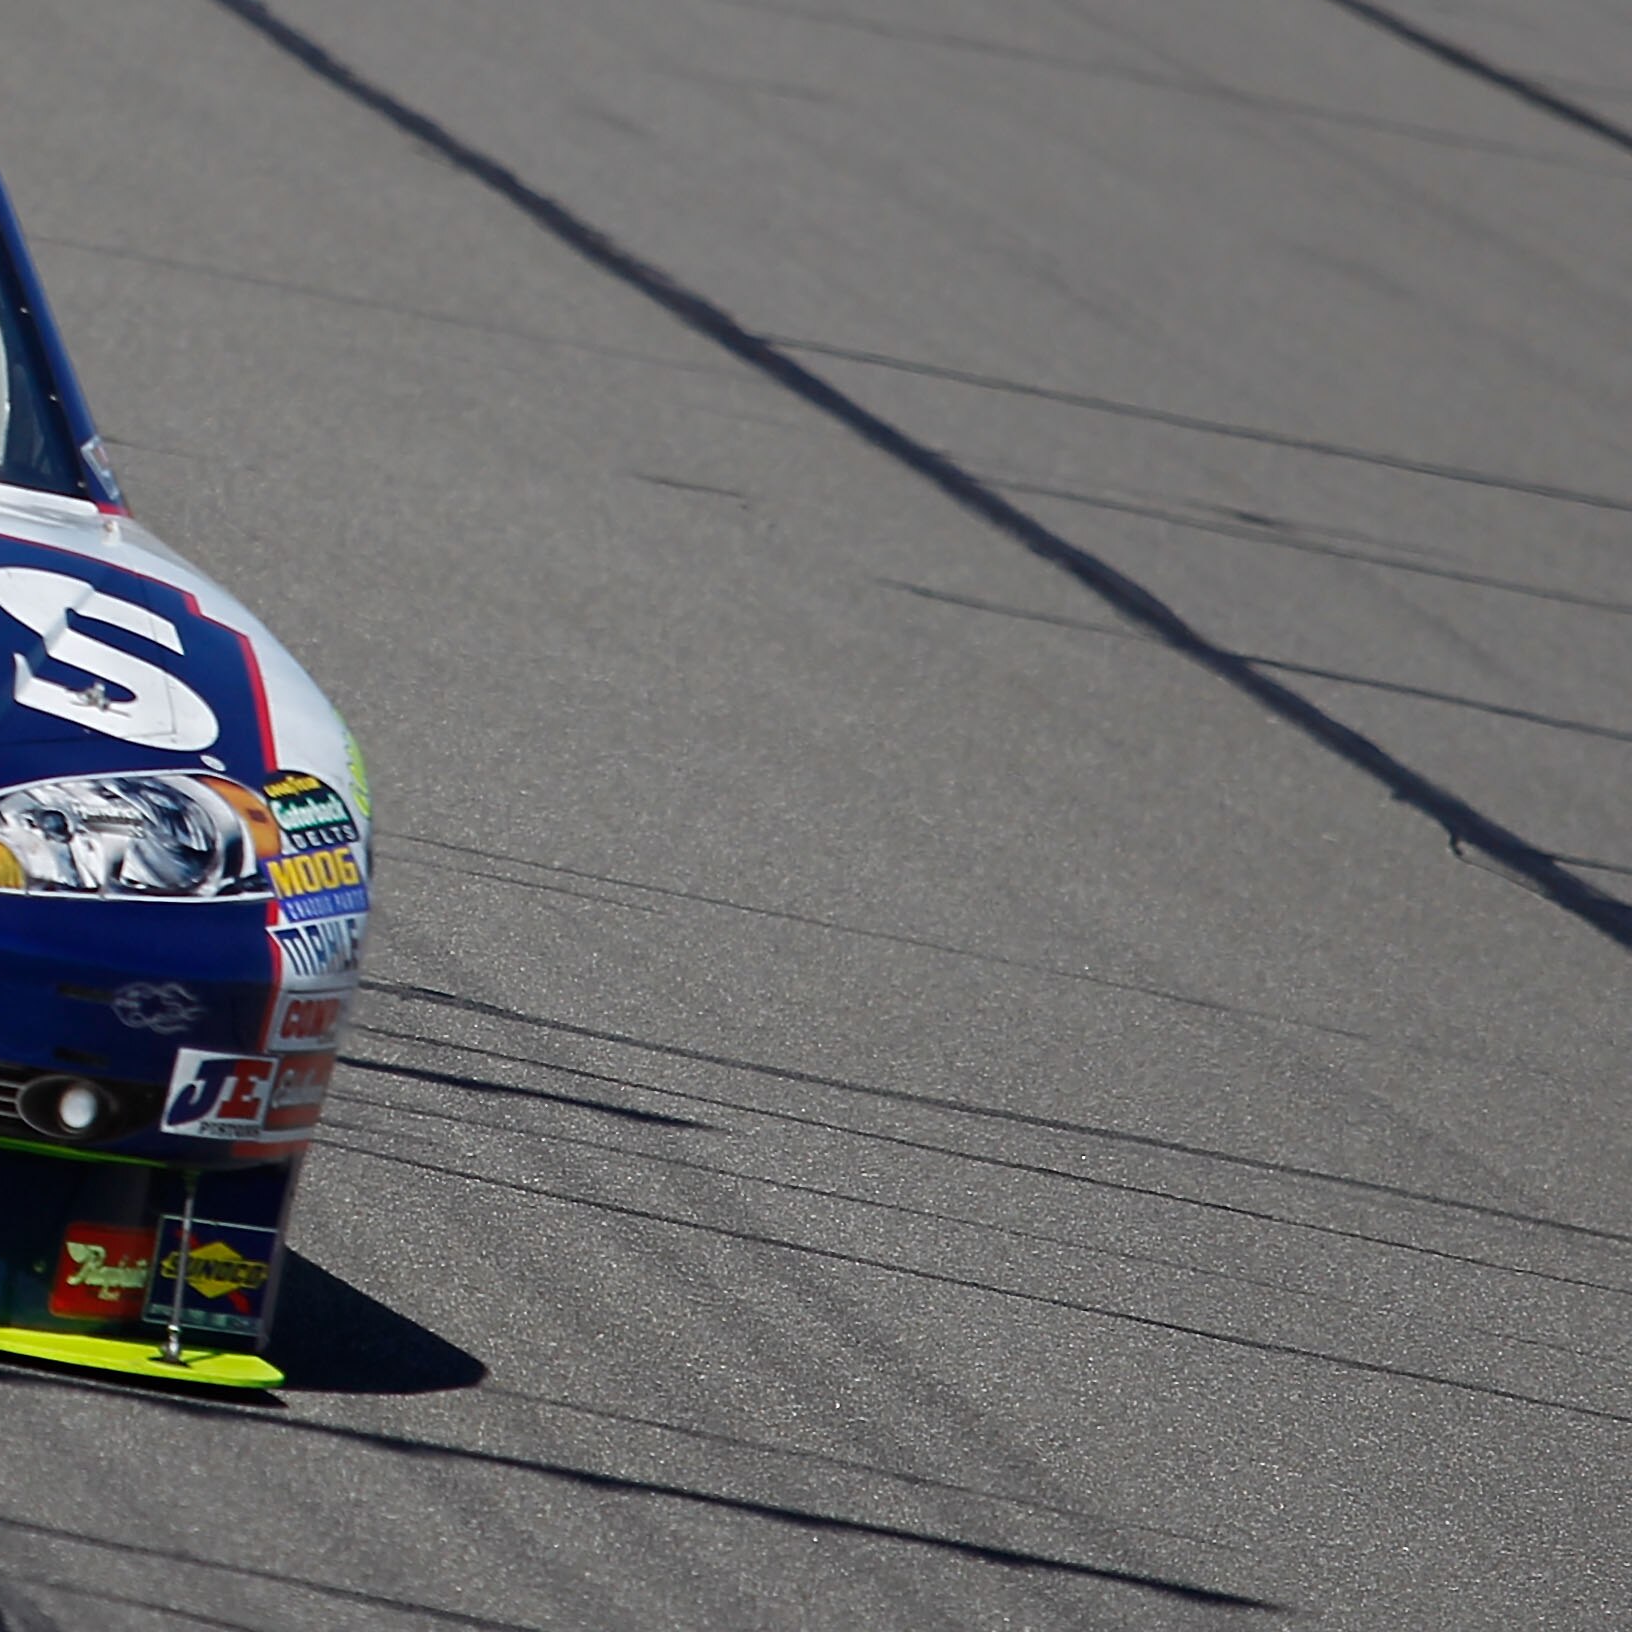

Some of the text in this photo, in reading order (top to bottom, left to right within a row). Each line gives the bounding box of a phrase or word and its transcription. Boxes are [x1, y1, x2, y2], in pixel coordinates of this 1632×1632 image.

[290, 824, 357, 850] BELTS
[266, 847, 361, 898] MOOG
[166, 1058, 274, 1126] JE
